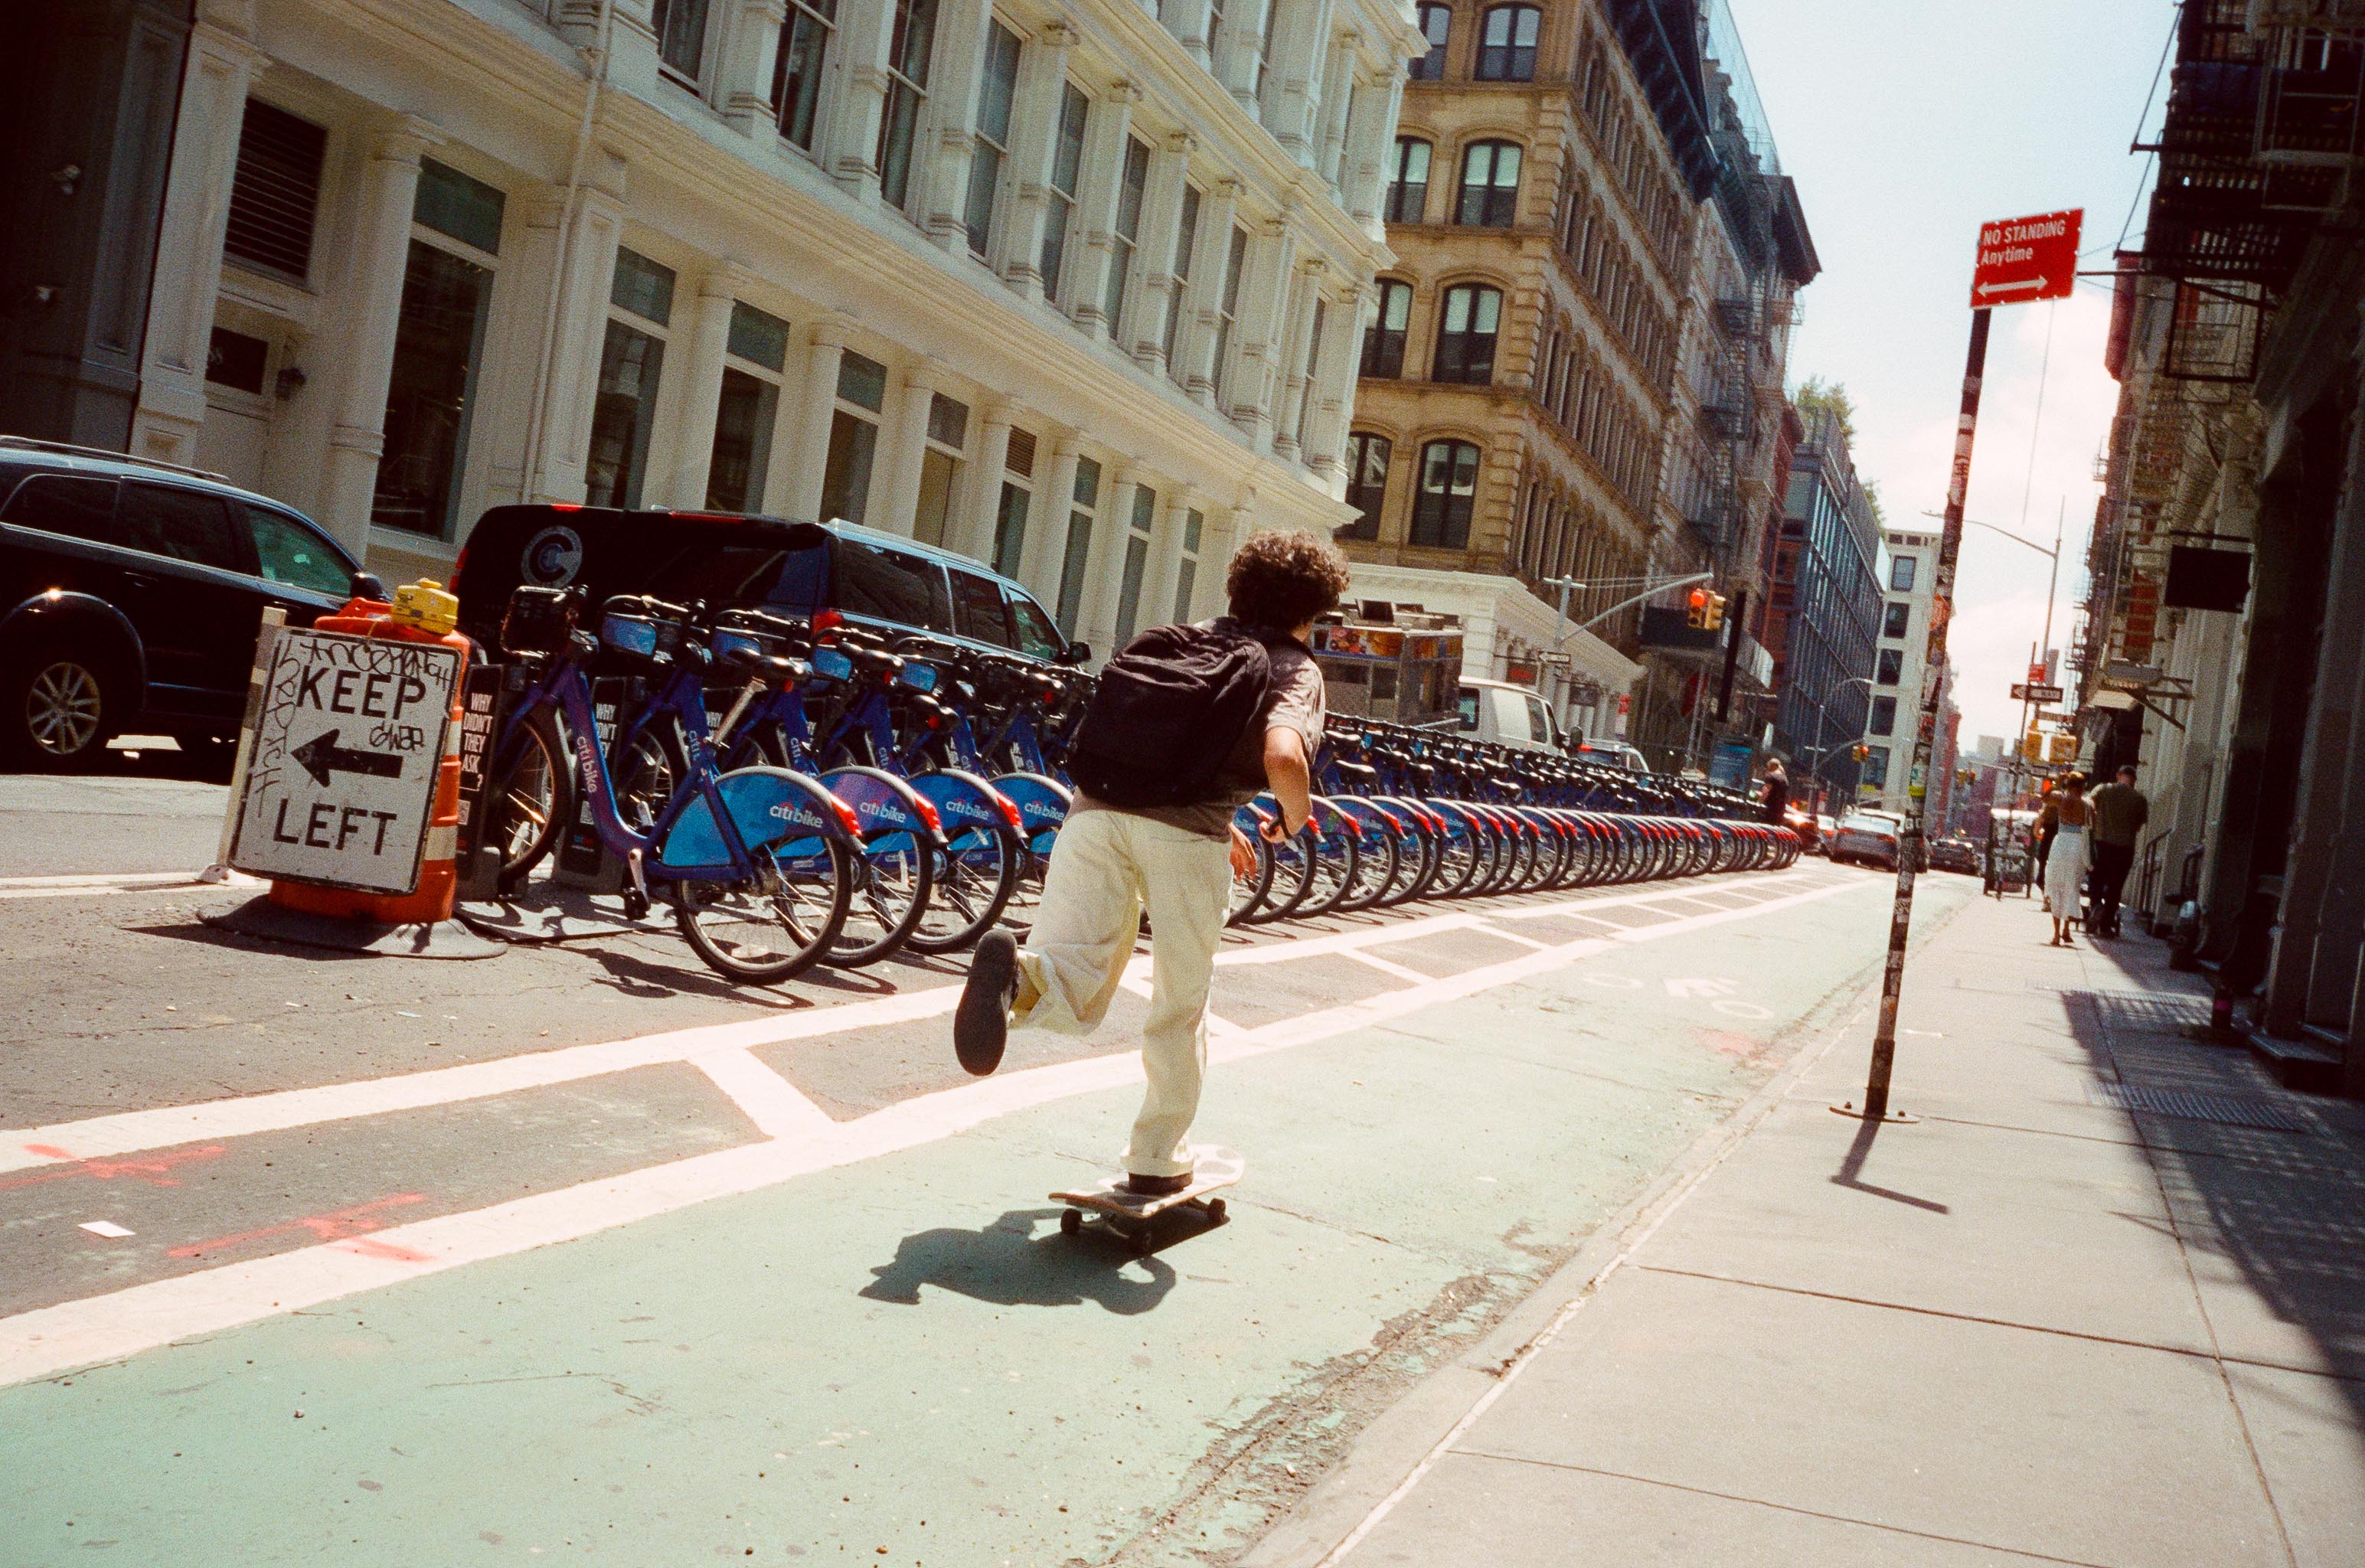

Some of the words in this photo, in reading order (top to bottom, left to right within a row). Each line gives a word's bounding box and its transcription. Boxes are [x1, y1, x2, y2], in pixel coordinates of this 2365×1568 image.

[1983, 230, 2001, 246] NO
[2004, 220, 2066, 243] STANDING
[1981, 247, 2033, 266] Anytime
[296, 665, 426, 720] KEEP
[471, 692, 492, 713] WHY
[596, 703, 616, 721] WHY
[463, 713, 493, 733] DIDN'T
[464, 733, 485, 753] THEY
[461, 754, 481, 773] ASK
[273, 797, 397, 855] LEFT
